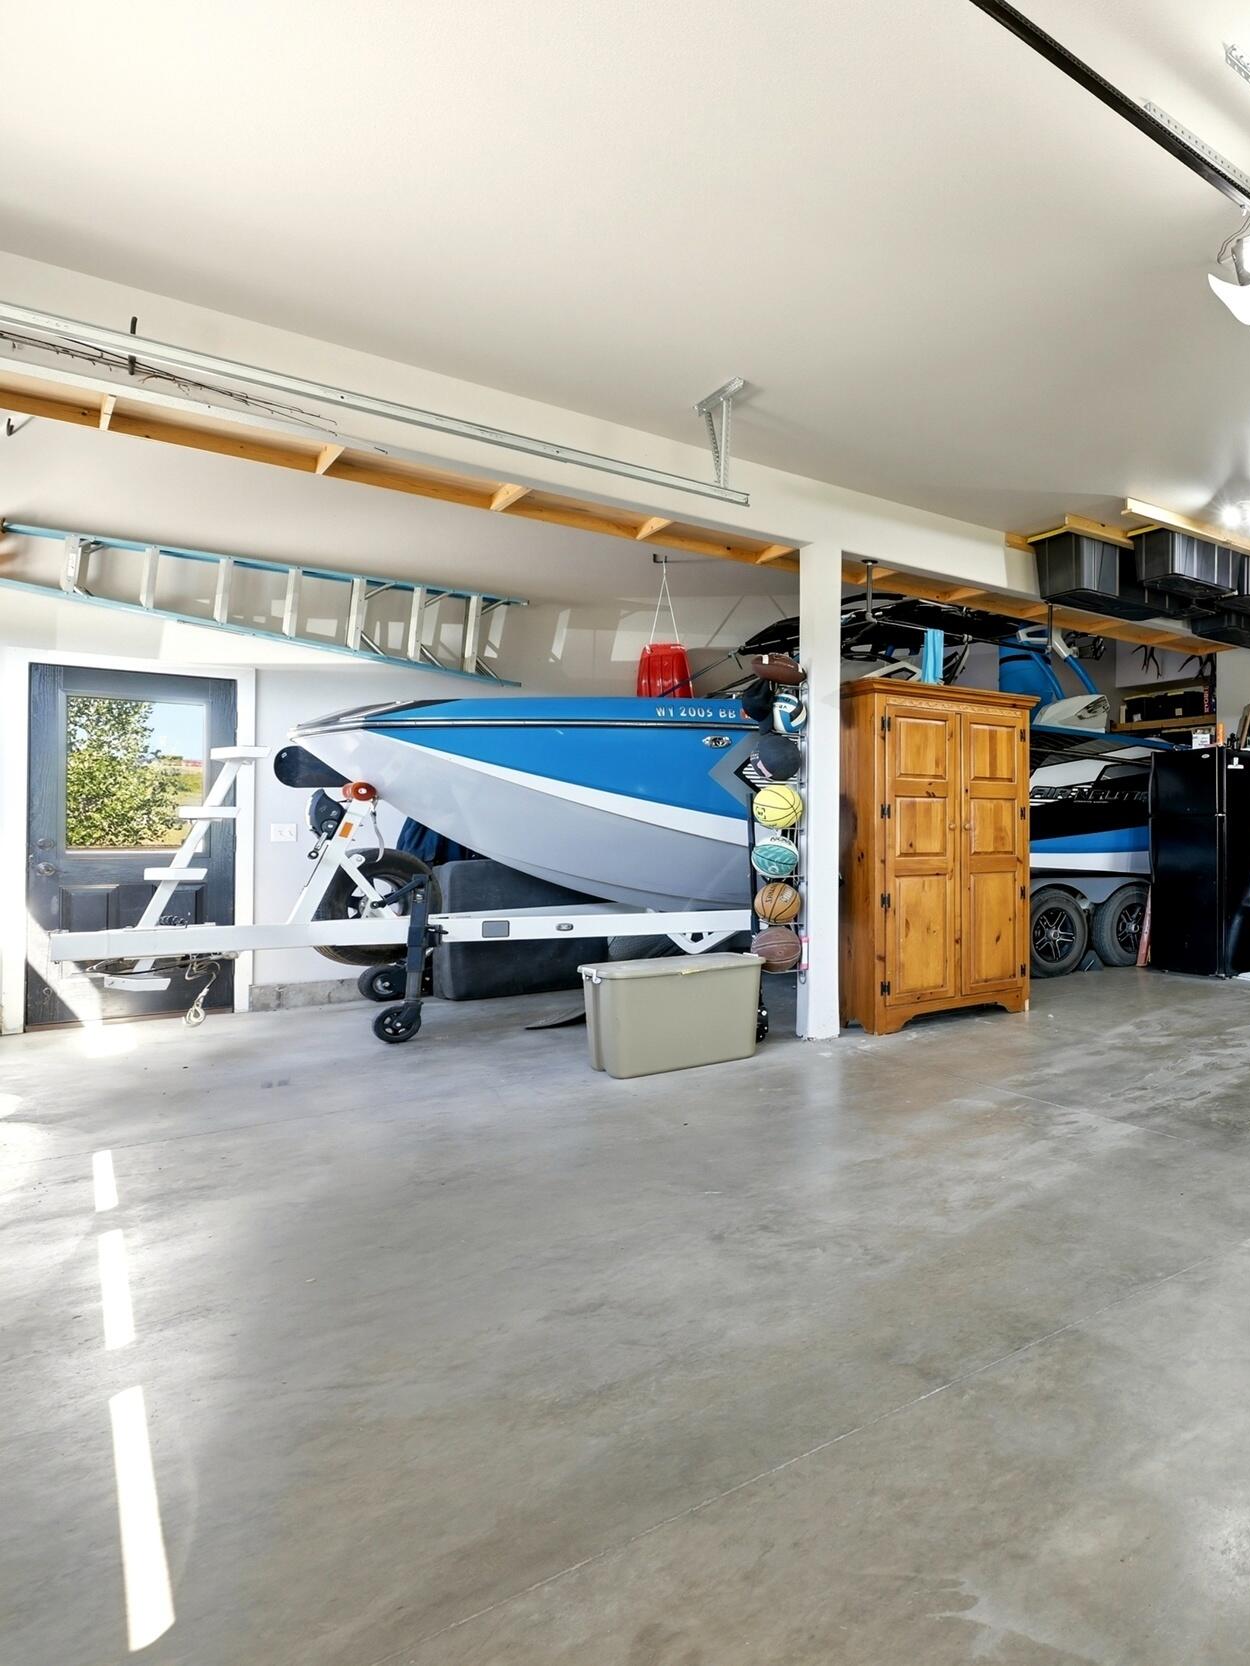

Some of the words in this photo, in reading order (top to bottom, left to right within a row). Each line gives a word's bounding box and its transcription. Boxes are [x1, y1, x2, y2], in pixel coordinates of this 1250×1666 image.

[656, 707, 674, 717] WY
[679, 706, 713, 718] 2005
[719, 708, 736, 719] BB
